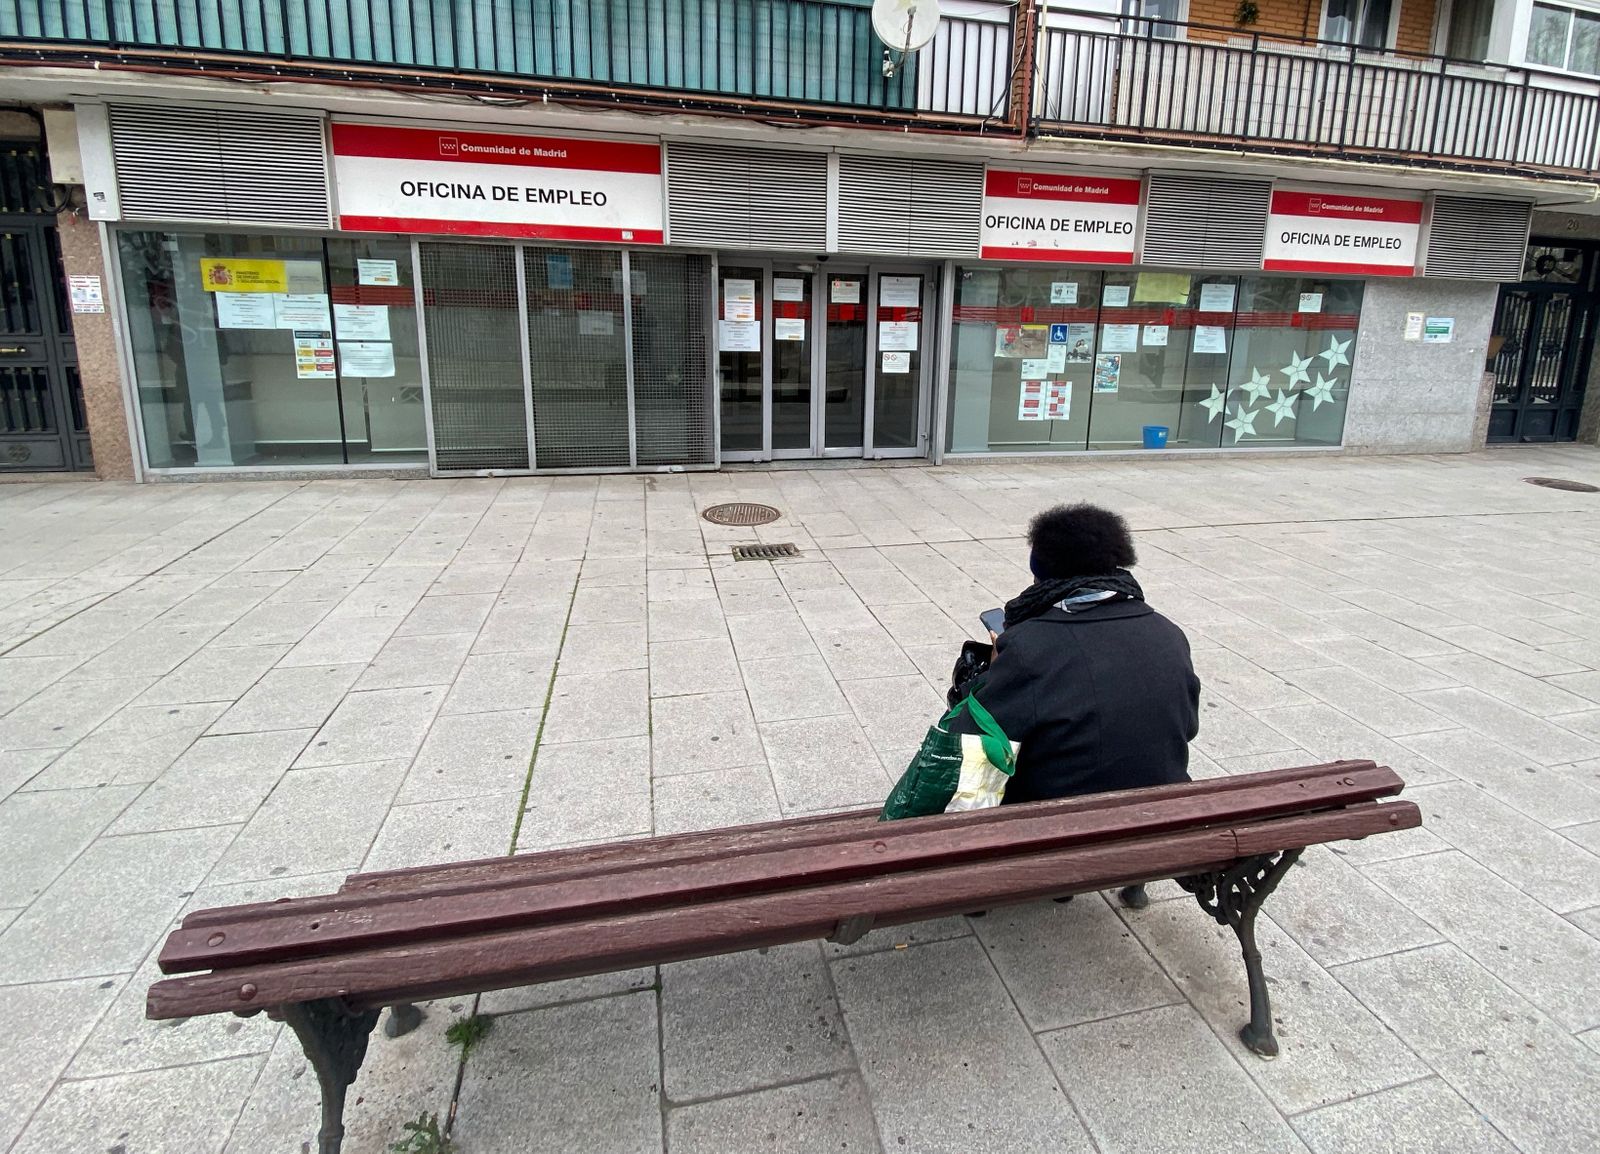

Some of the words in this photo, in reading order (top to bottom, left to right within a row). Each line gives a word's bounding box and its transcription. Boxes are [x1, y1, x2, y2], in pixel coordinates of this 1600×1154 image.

[461, 144, 517, 156] Comunidad
[519, 147, 531, 156] de
[533, 147, 567, 158] Madrid
[400, 181, 486, 200] OFICINA
[492, 185, 519, 202] DE
[526, 188, 607, 207] EMPLEO
[1033, 183, 1072, 194] Comunidad
[1074, 185, 1083, 194] de
[1084, 186, 1109, 195] Madrid
[1321, 202, 1353, 212] Comunidad
[1354, 204, 1362, 213] de
[1362, 204, 1384, 214] Madrid
[985, 214, 1046, 231] OFICINA
[1050, 217, 1070, 232] DE
[1074, 220, 1133, 235] EMPLEO
[1280, 231, 1330, 247] OFICINA
[1334, 234, 1351, 247] DE
[1353, 236, 1402, 250] EMPLEO
